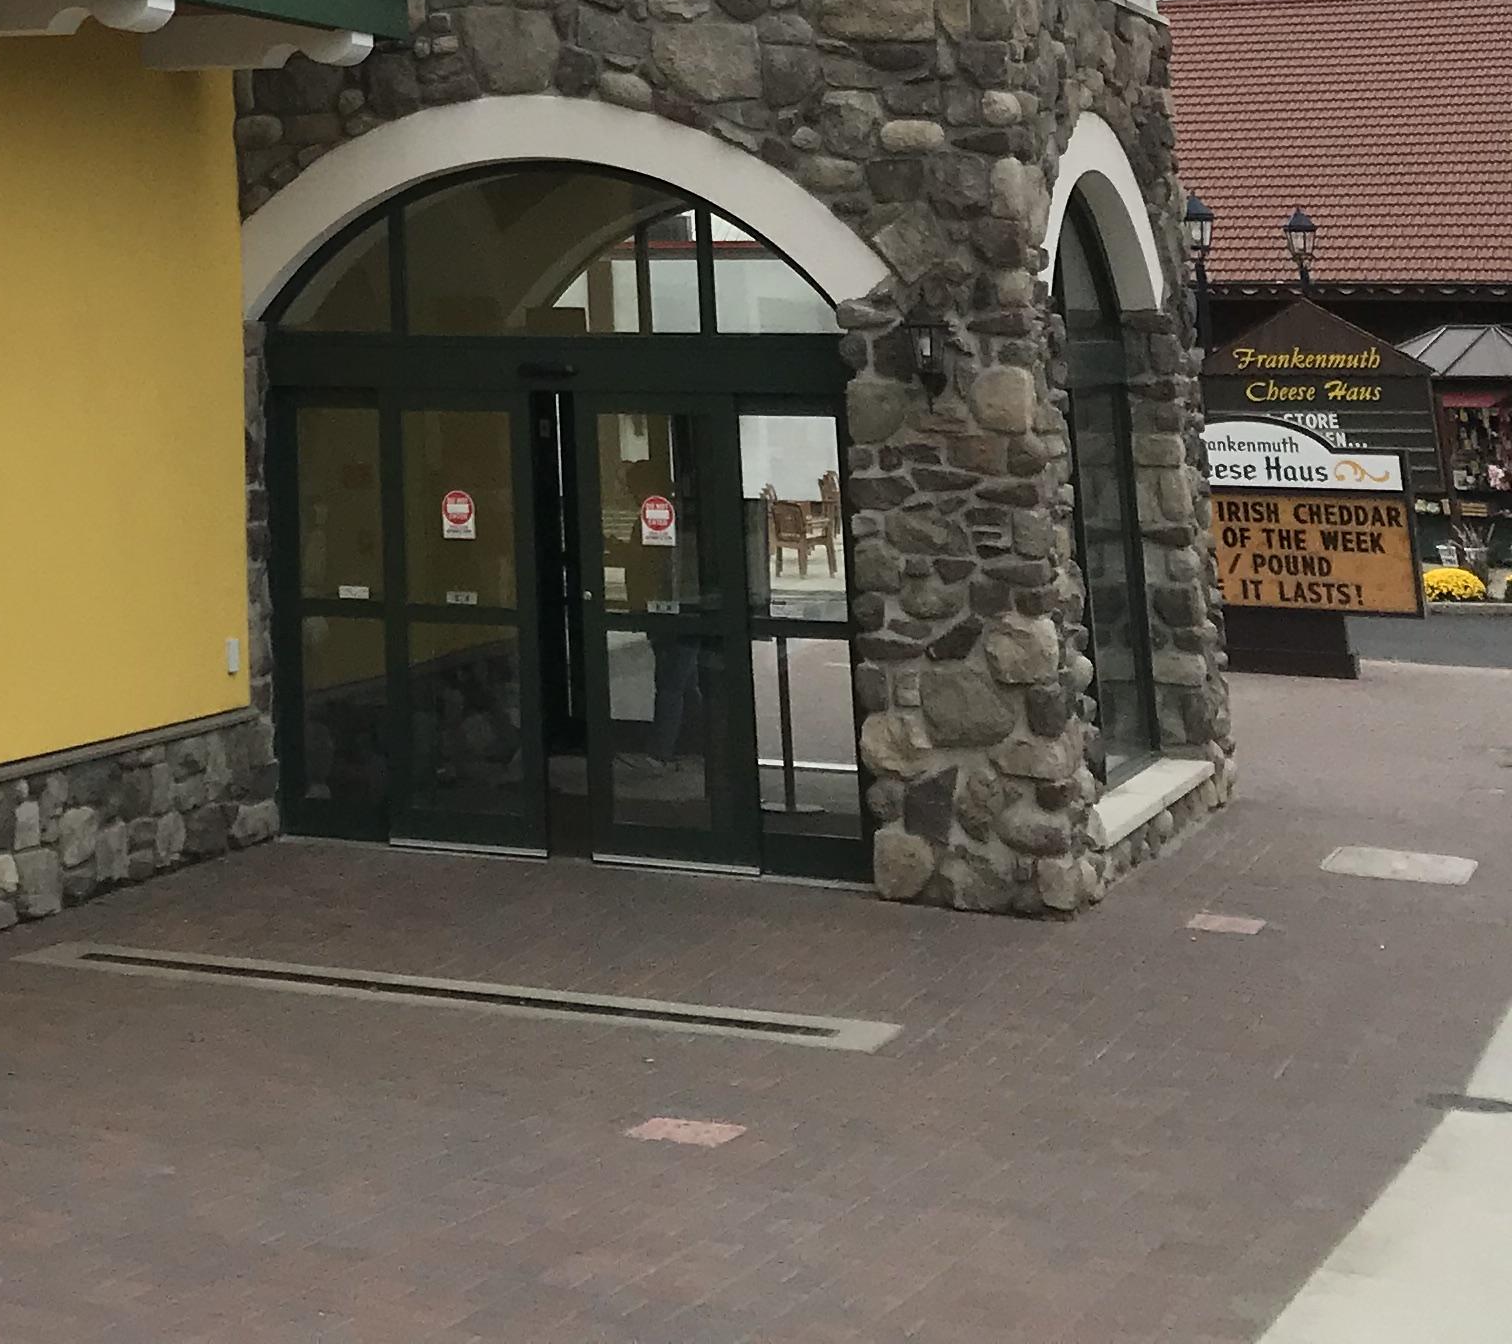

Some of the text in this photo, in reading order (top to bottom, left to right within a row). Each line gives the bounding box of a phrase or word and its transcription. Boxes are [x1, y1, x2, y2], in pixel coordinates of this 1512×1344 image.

[1232, 346, 1381, 370] Frankenmuth
[1245, 379, 1382, 402] Cheese Haus
[1207, 433, 1300, 453] ankenmuth
[1264, 455, 1328, 483] Haus
[1217, 501, 1403, 528] IRISH CHEDDAR
[1222, 527, 1386, 554] OF THE WEEK
[1252, 554, 1332, 577] POUND
[1241, 579, 1263, 601] IT
[1279, 580, 1364, 606] LASTS!
